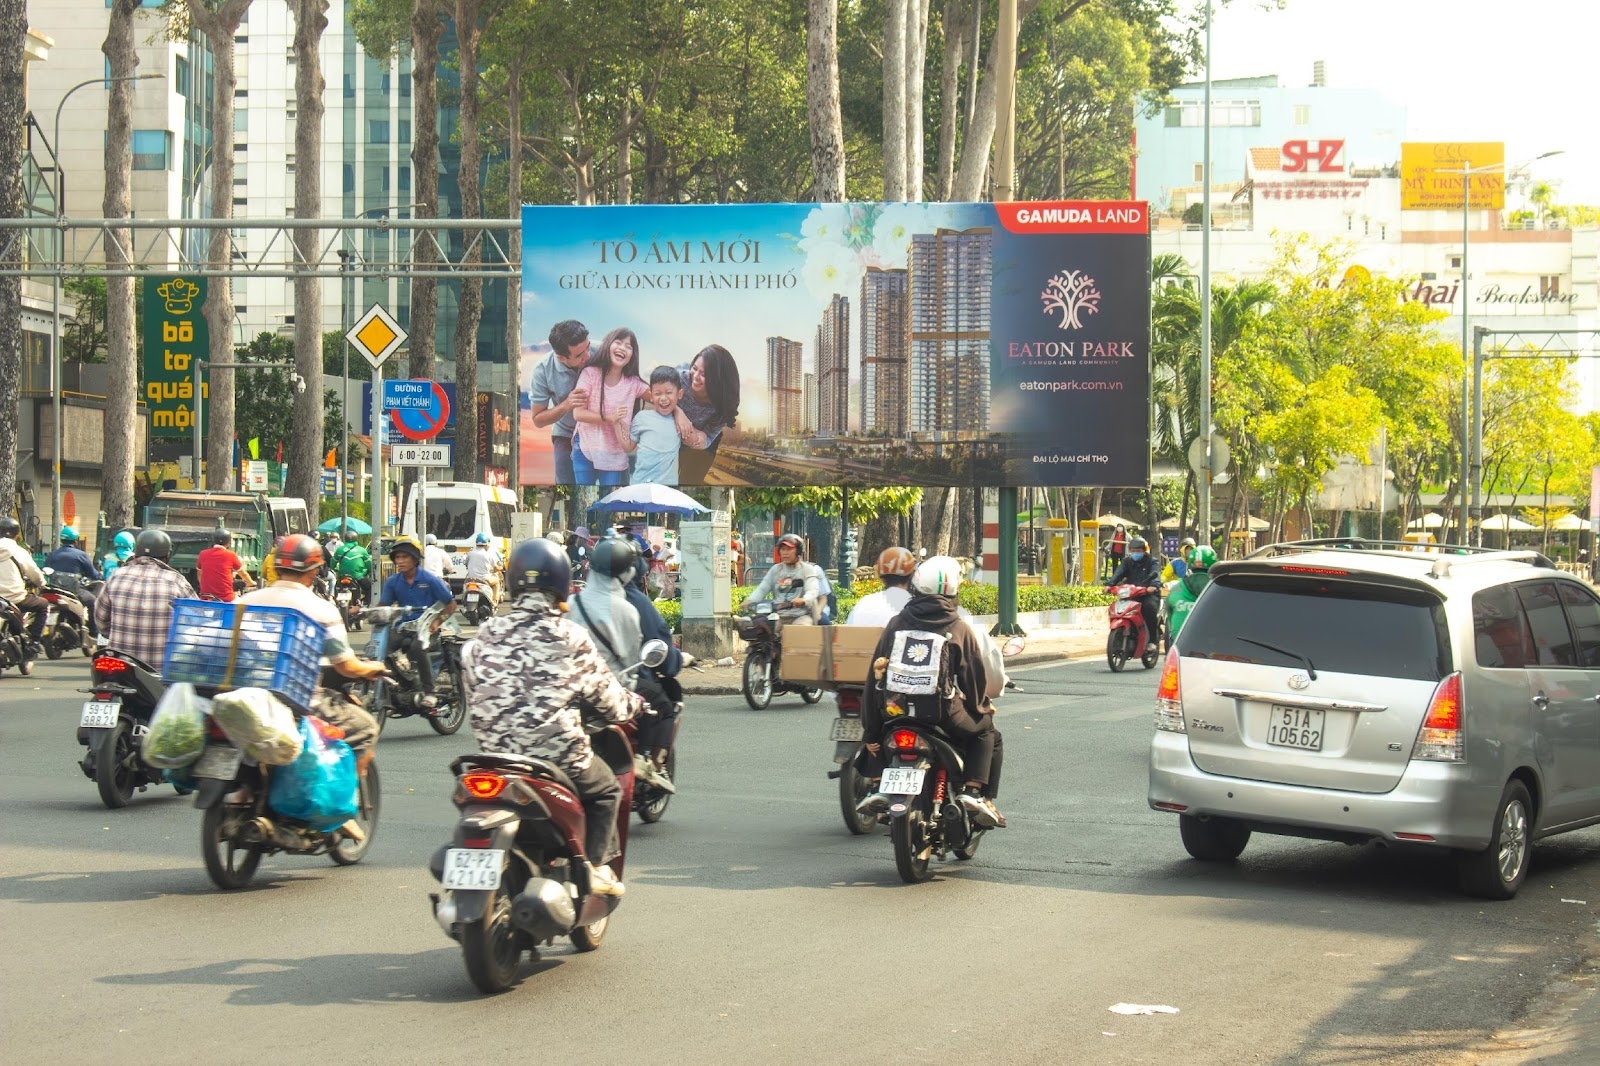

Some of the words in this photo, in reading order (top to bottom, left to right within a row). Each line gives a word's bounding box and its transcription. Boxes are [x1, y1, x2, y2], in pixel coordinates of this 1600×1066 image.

[1282, 139, 1345, 173] SHZ
[1016, 209, 1092, 224] GAMUDA
[1097, 209, 1141, 223] LAND
[592, 232, 638, 264] TỔ
[643, 231, 691, 264] ẤM
[700, 233, 761, 264] MỚI
[559, 270, 610, 290] GIỮA
[615, 270, 671, 290] LÒNG
[675, 270, 749, 289] THÀNH
[755, 267, 797, 289] PHỐ
[1476, 283, 1579, 305] Bookstore
[1008, 341, 1075, 358] EATON
[1082, 341, 1135, 358] PARK
[164, 349, 192, 371] tơ
[394, 383, 423, 393] ĐƯỜNG
[1020, 380, 1123, 392] eatonpark.com.vn
[412, 395, 430, 407] CHÁNH
[153, 404, 195, 432] mộ
[1033, 455, 1047, 465] ĐẠI
[1049, 454, 1059, 464] LỘ
[1060, 455, 1076, 463] MAI
[1076, 454, 1091, 463] CHÍ
[1092, 455, 1109, 464] THỌ
[88, 704, 113, 715] 59-C1
[1282, 708, 1311, 728] 51A
[1270, 726, 1320, 748] 105.62
[888, 770, 917, 781] 66-M1
[883, 782, 918, 793] 711.25
